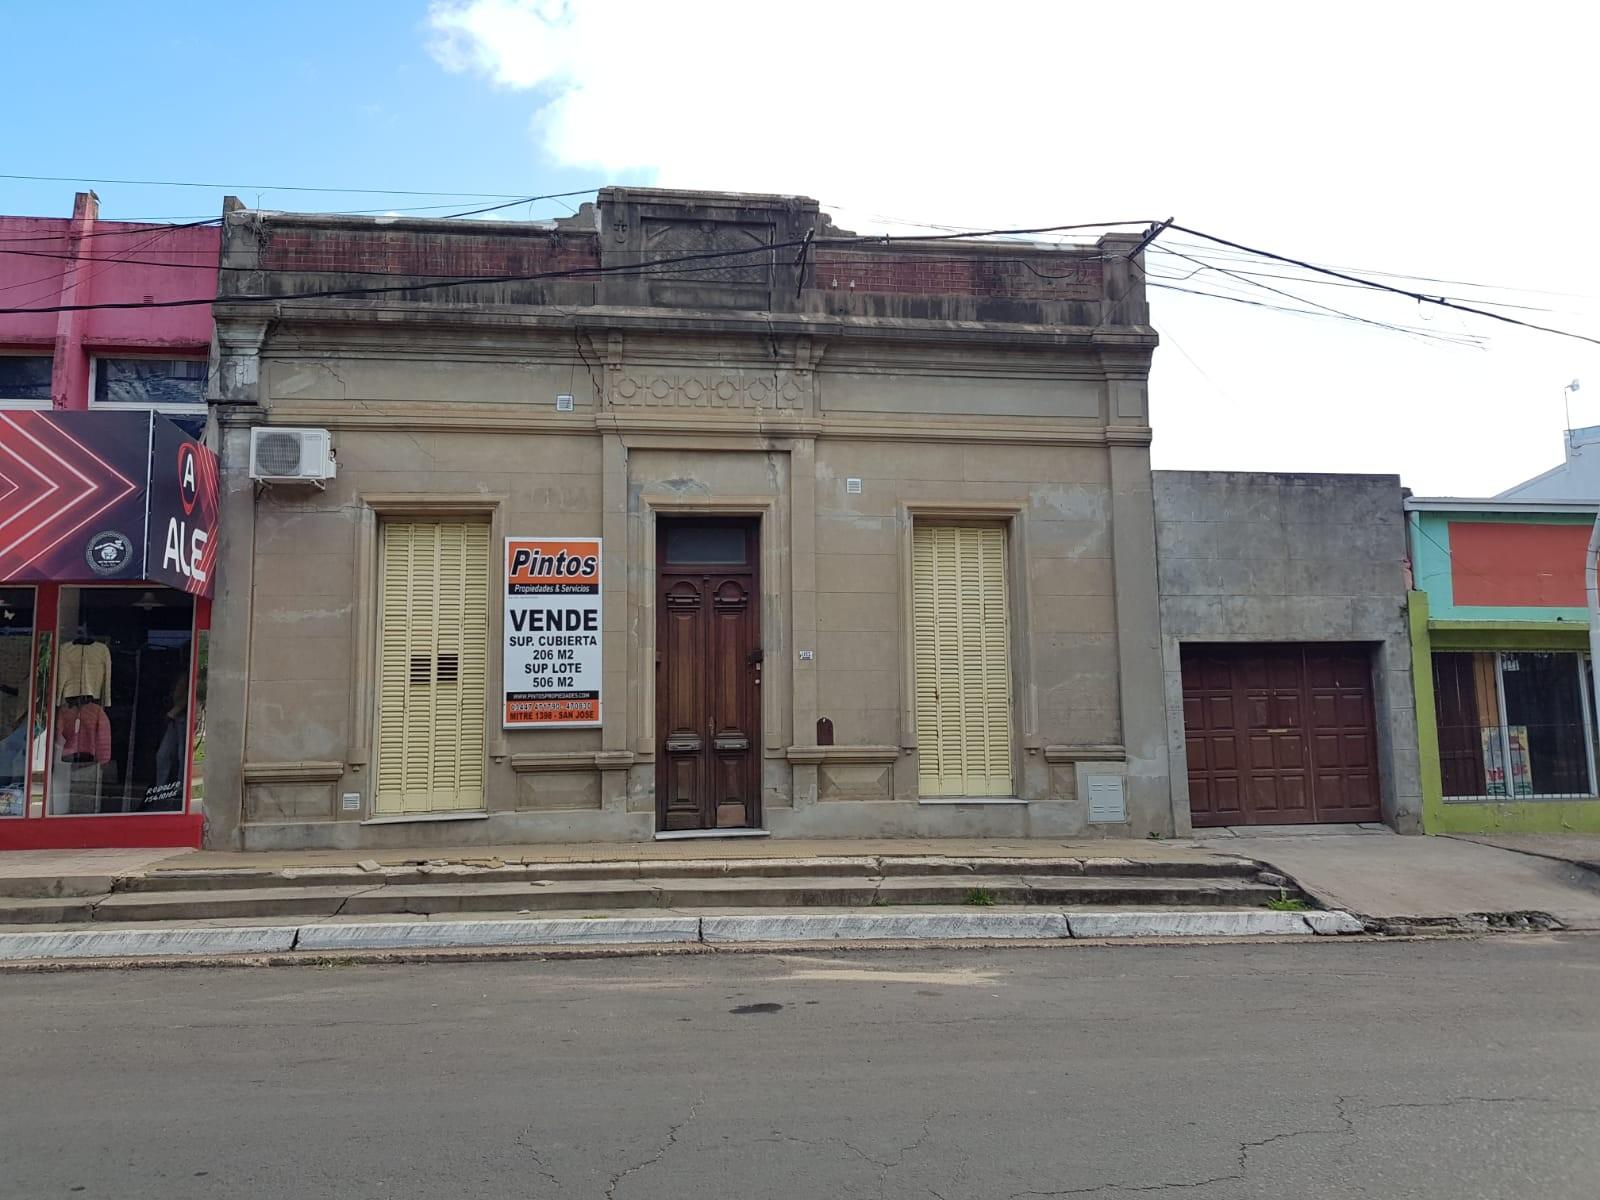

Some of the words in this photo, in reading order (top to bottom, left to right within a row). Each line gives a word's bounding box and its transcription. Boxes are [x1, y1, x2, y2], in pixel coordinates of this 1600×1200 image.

[183, 453, 195, 493] A
[163, 517, 208, 582] ALE
[510, 548, 598, 577] Pintos
[514, 584, 554, 594] Propiedades
[555, 584, 560, 593] &
[561, 584, 590, 593] Servicios
[509, 609, 598, 632] VENDE
[509, 636, 535, 647] SUP.
[538, 635, 597, 646] CUBIERTA
[533, 649, 554, 660] 206
[557, 649, 574, 660] M2
[524, 663, 548, 674] SUP
[552, 663, 582, 674] LOTE
[533, 677, 554, 688] 506
[557, 676, 574, 687] M2
[509, 712, 533, 720] MITRE
[559, 711, 573, 719] SAN
